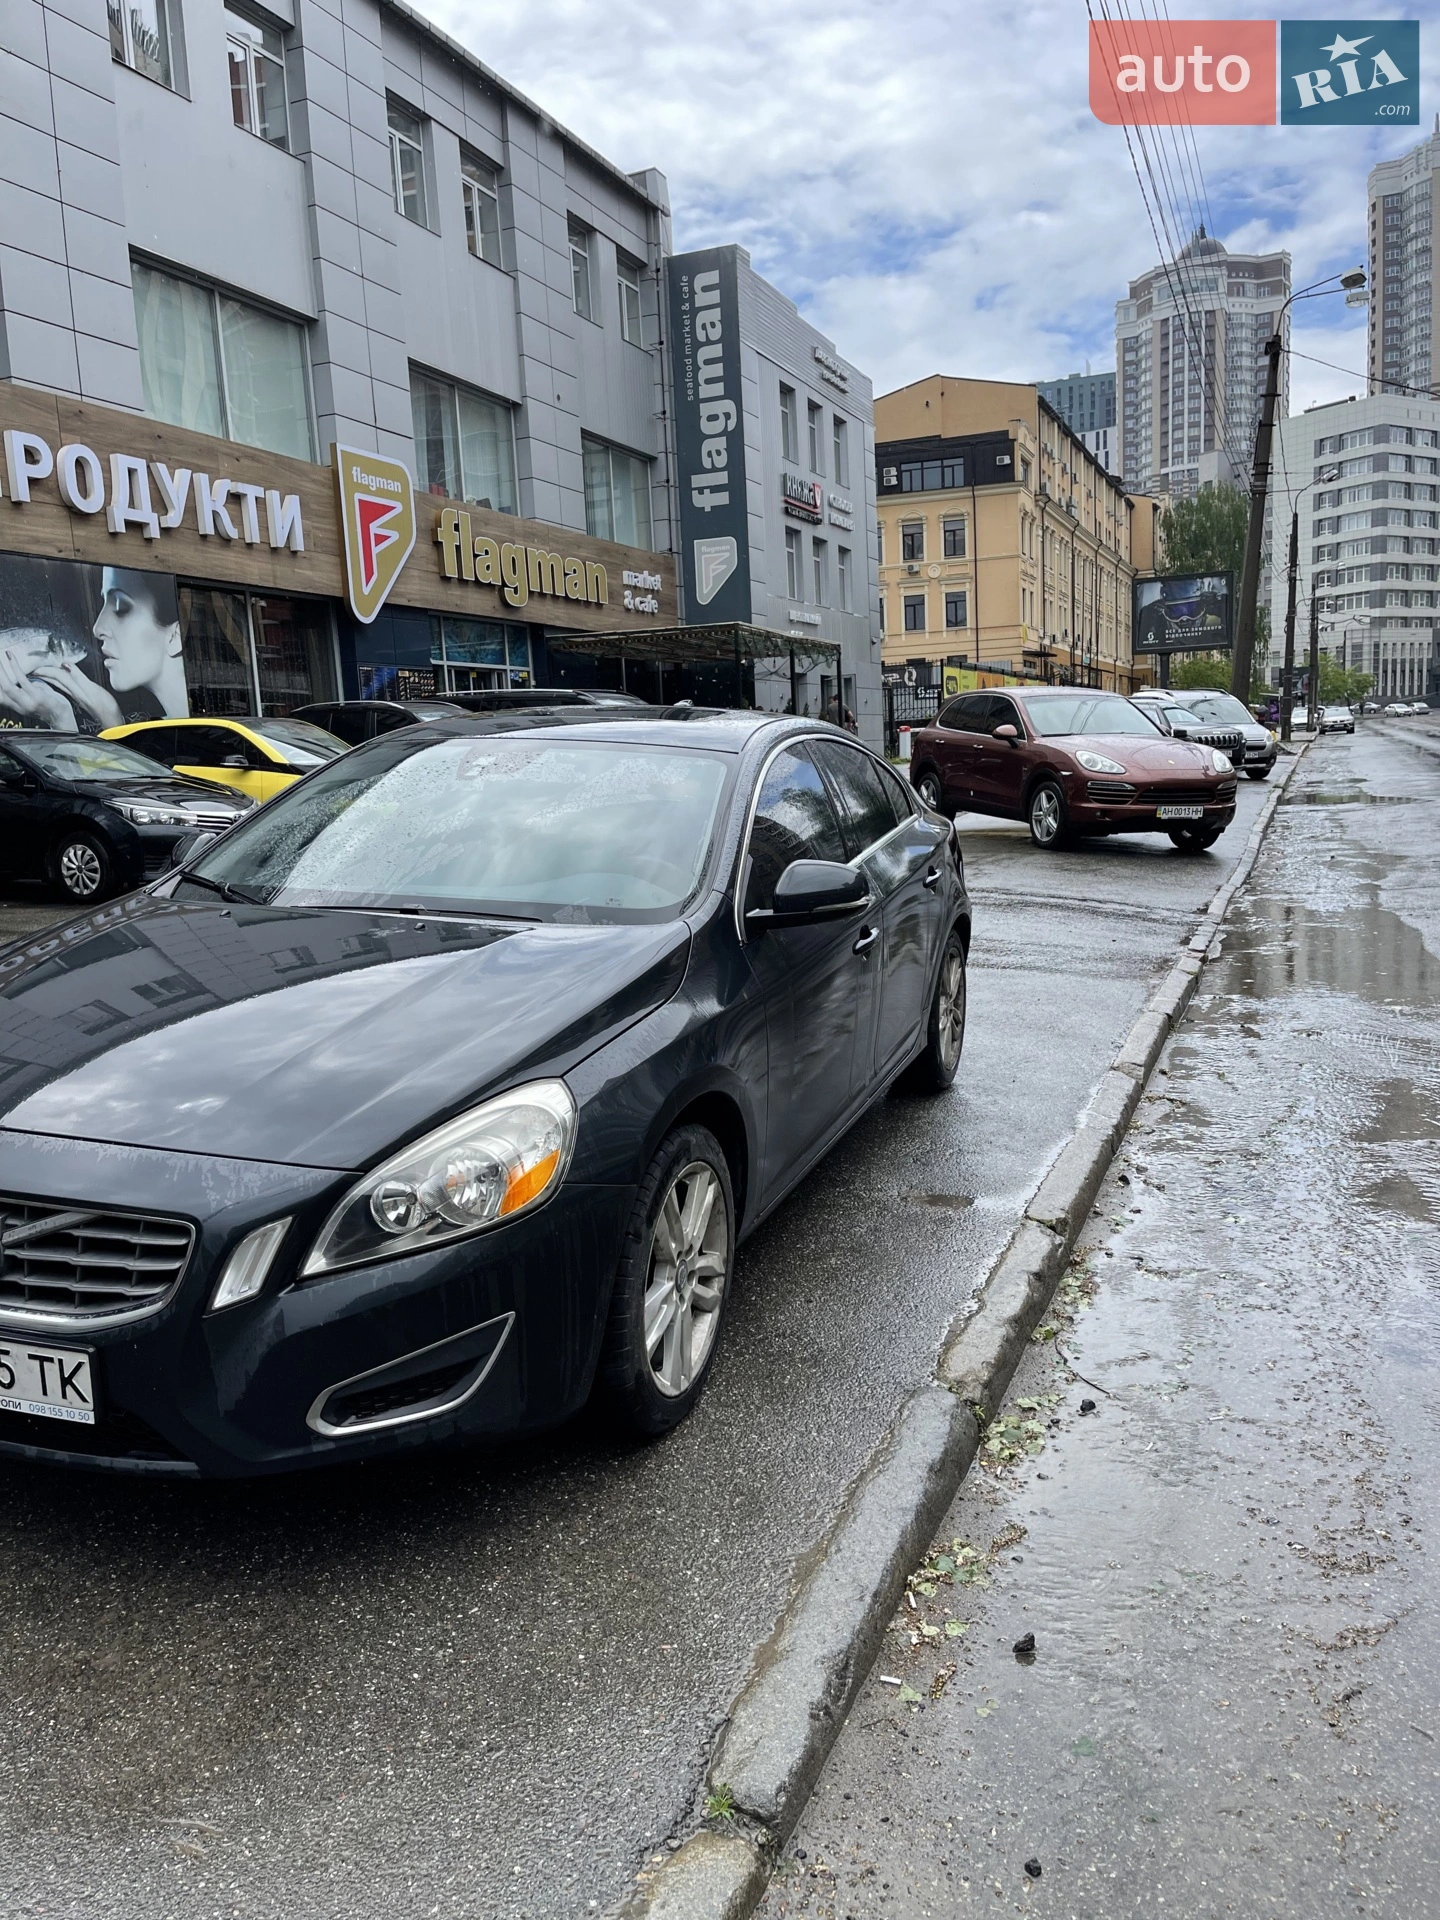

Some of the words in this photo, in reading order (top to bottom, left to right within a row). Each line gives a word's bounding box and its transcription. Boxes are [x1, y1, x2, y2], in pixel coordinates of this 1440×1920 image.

[680, 275, 690, 299] cafe
[681, 302, 690, 311] &
[682, 314, 692, 355] market
[684, 358, 694, 401] seafood
[690, 269, 738, 513] flagman
[0, 430, 305, 552] РОДУКТИ
[351, 466, 402, 493] flagman
[435, 507, 609, 607] flagman
[701, 544, 731, 553] flagman
[622, 570, 662, 591] market
[623, 590, 634, 609] &
[634, 594, 659, 613] cafe
[27, 1353, 90, 1404] TK
[29, 1403, 46, 1415] 098
[48, 1406, 63, 1417] 155
[65, 1410, 76, 1420] 10
[78, 1412, 90, 1422] 50
